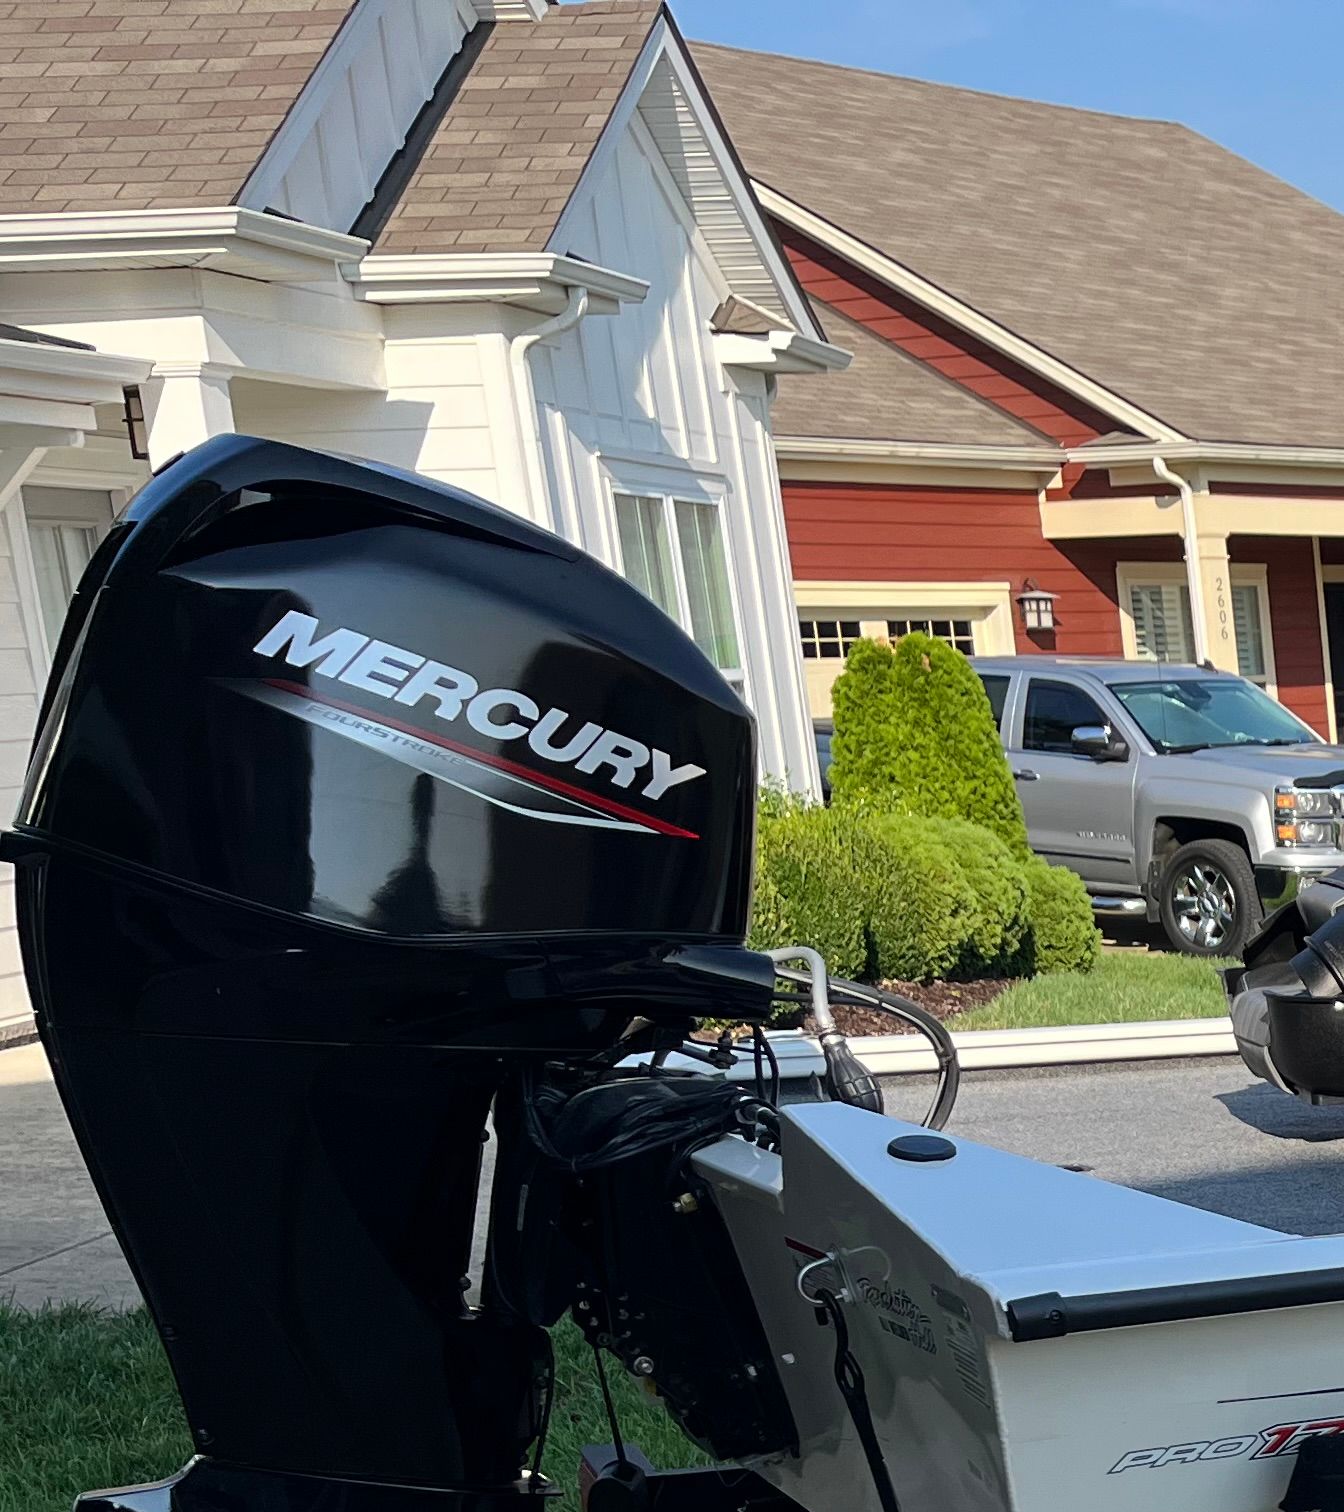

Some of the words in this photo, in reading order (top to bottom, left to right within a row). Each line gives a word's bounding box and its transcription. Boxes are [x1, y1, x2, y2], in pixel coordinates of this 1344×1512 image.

[1216, 577, 1229, 641] 2606
[253, 610, 707, 800] MERCURY
[304, 703, 466, 766] FOURSTROKE
[1107, 1435, 1258, 1474] PRO
